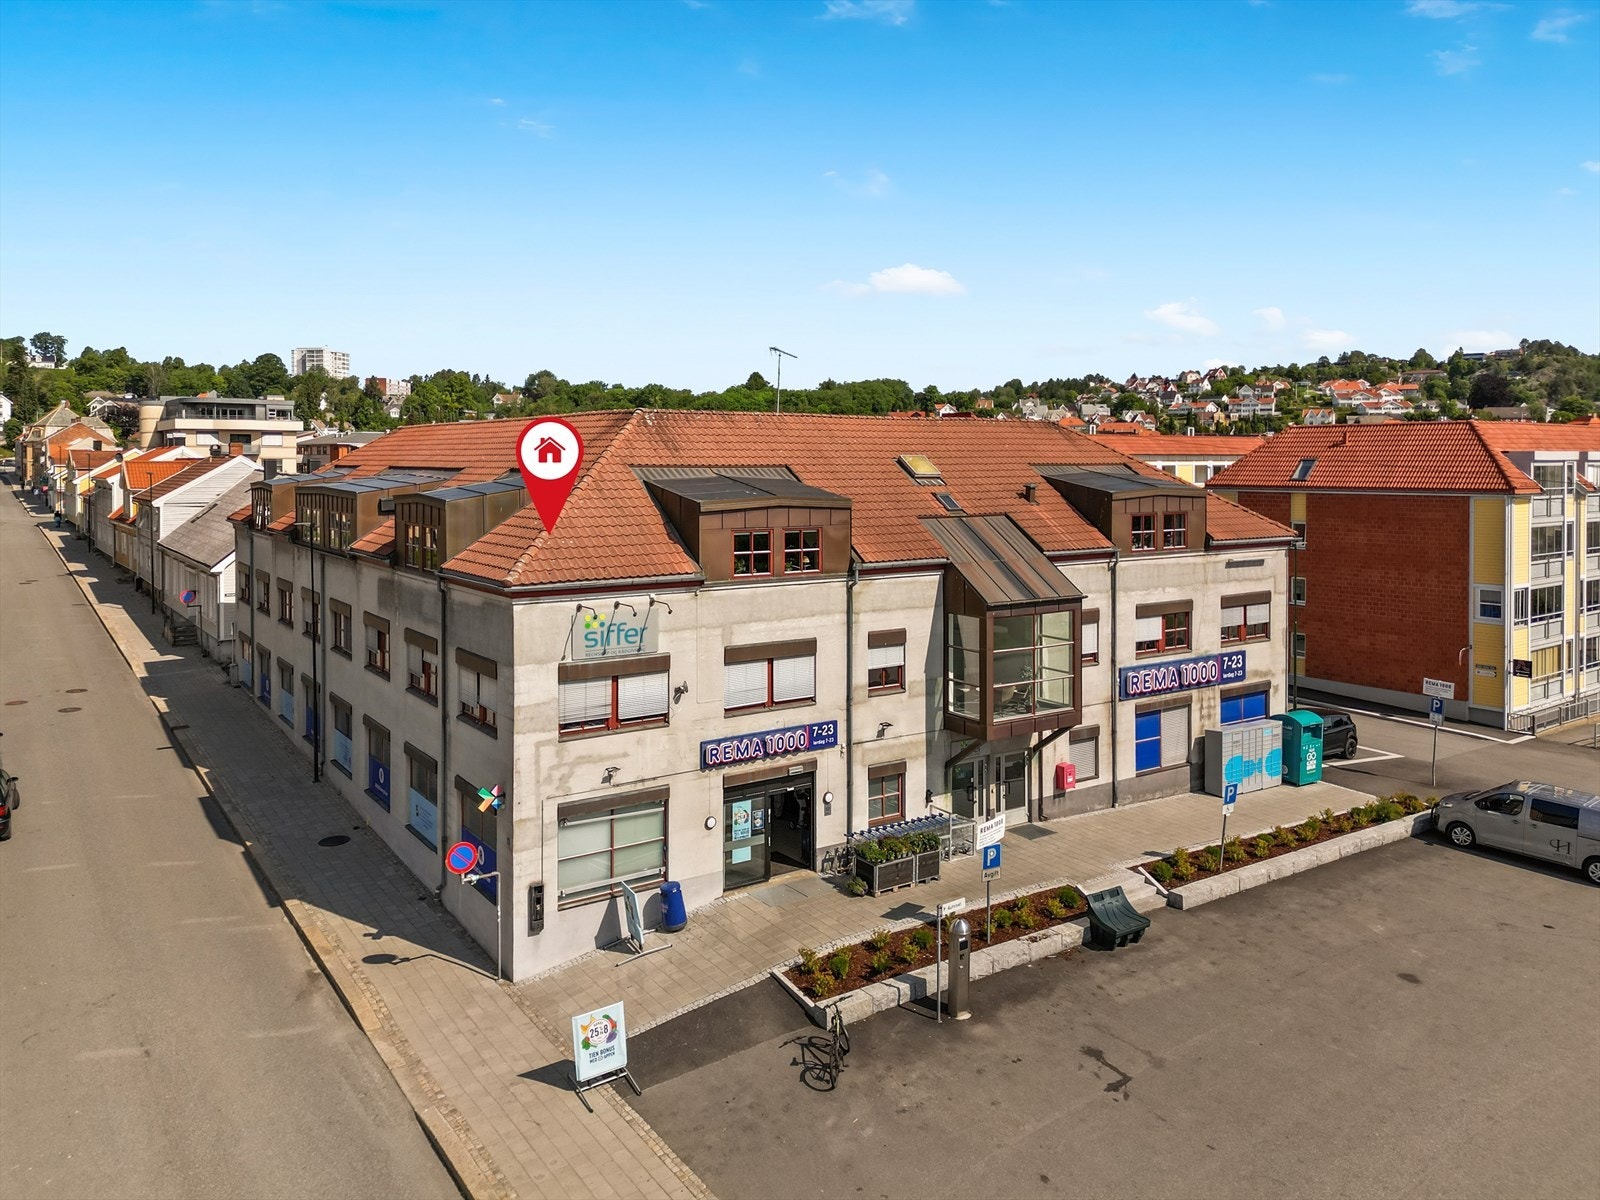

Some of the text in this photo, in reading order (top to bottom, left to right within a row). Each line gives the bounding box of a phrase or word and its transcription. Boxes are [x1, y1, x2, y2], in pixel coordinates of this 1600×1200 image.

[584, 622, 648, 648] siffer
[1223, 655, 1243, 670] 7-23
[1127, 660, 1218, 695] REMA 1000
[1432, 699, 1441, 712] P
[812, 723, 834, 738] 7-23
[706, 730, 807, 765] REMA 1000
[1306, 751, 1317, 761] GO
[1226, 786, 1235, 802] P
[980, 818, 1004, 833] REMA 1000
[986, 847, 997, 867] P
[983, 870, 1000, 879] Avgift
[589, 1027, 599, 1039] 25
[603, 1024, 609, 1034] 8
[600, 1045, 615, 1055] BONUS
